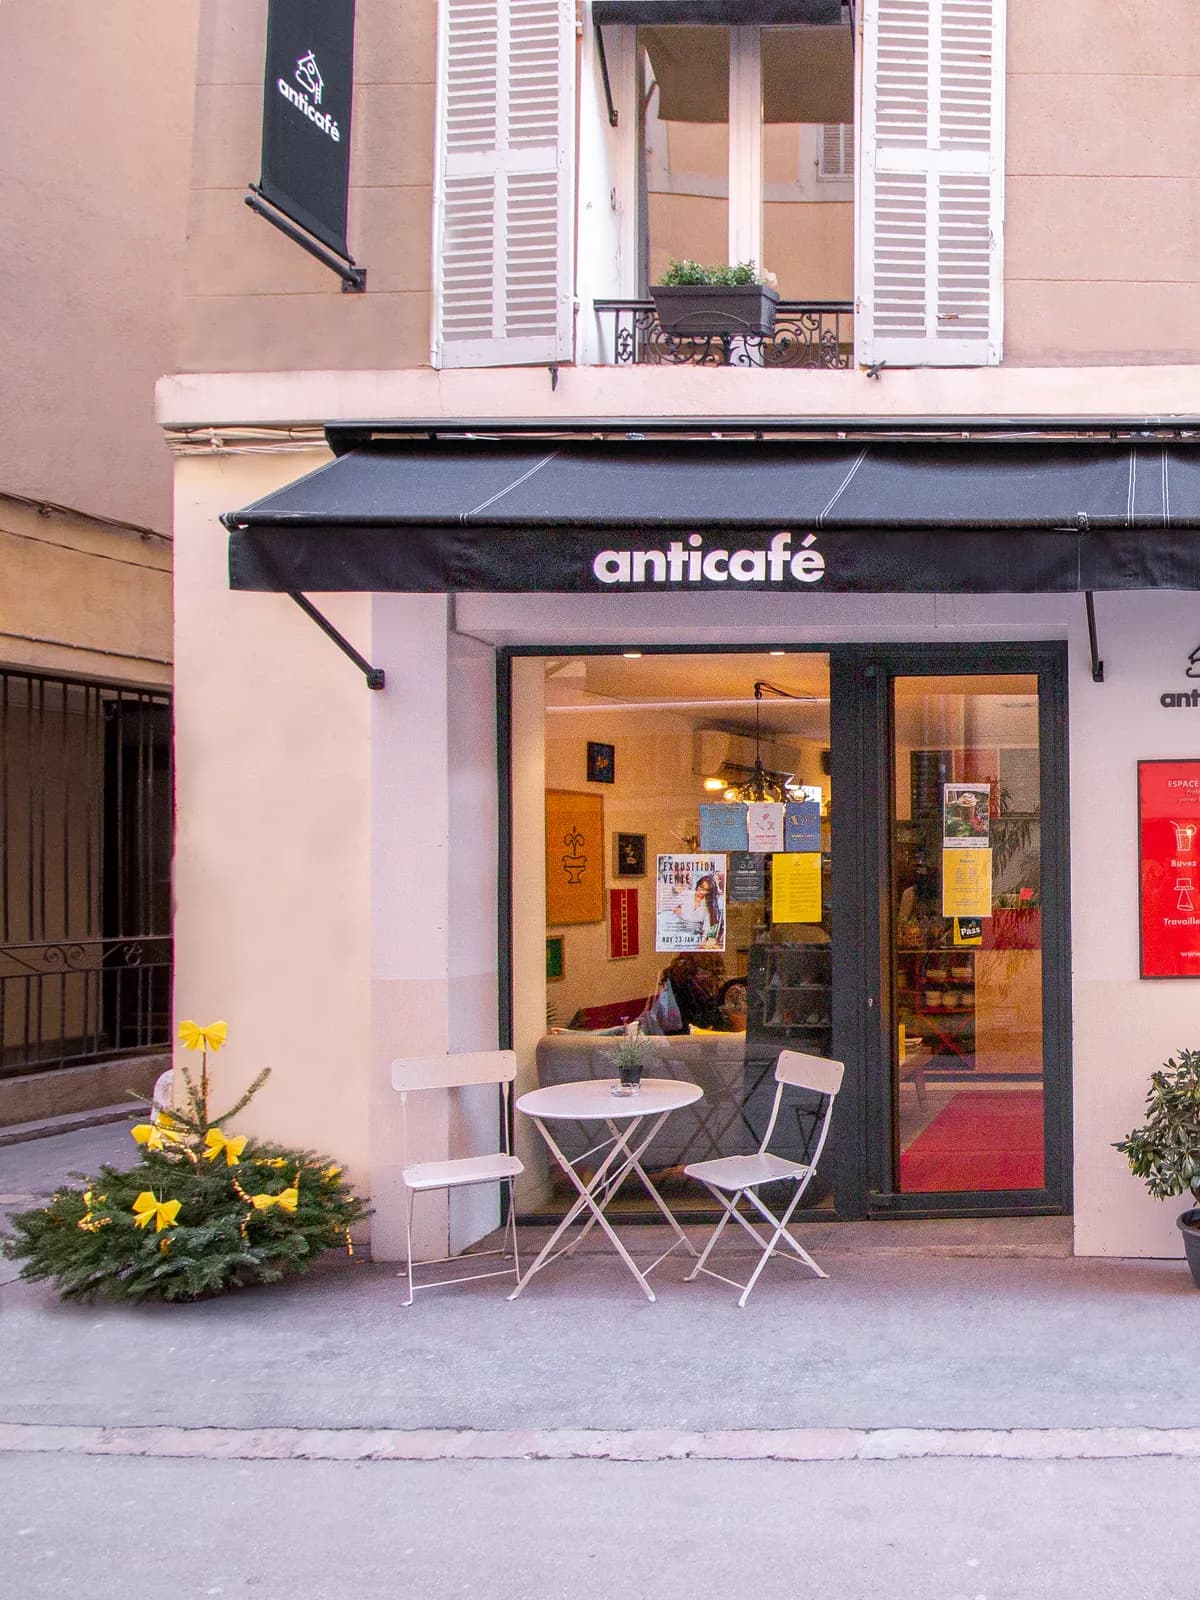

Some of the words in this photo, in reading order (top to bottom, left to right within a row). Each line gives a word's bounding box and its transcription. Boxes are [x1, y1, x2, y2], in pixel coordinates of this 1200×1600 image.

[278, 78, 341, 141] anticafé
[593, 531, 826, 584] anticafé
[1167, 779, 1199, 788] ESPACE
[663, 861, 716, 872] EXPOSITION
[1171, 859, 1197, 867] Buvez
[960, 927, 981, 936] Pass
